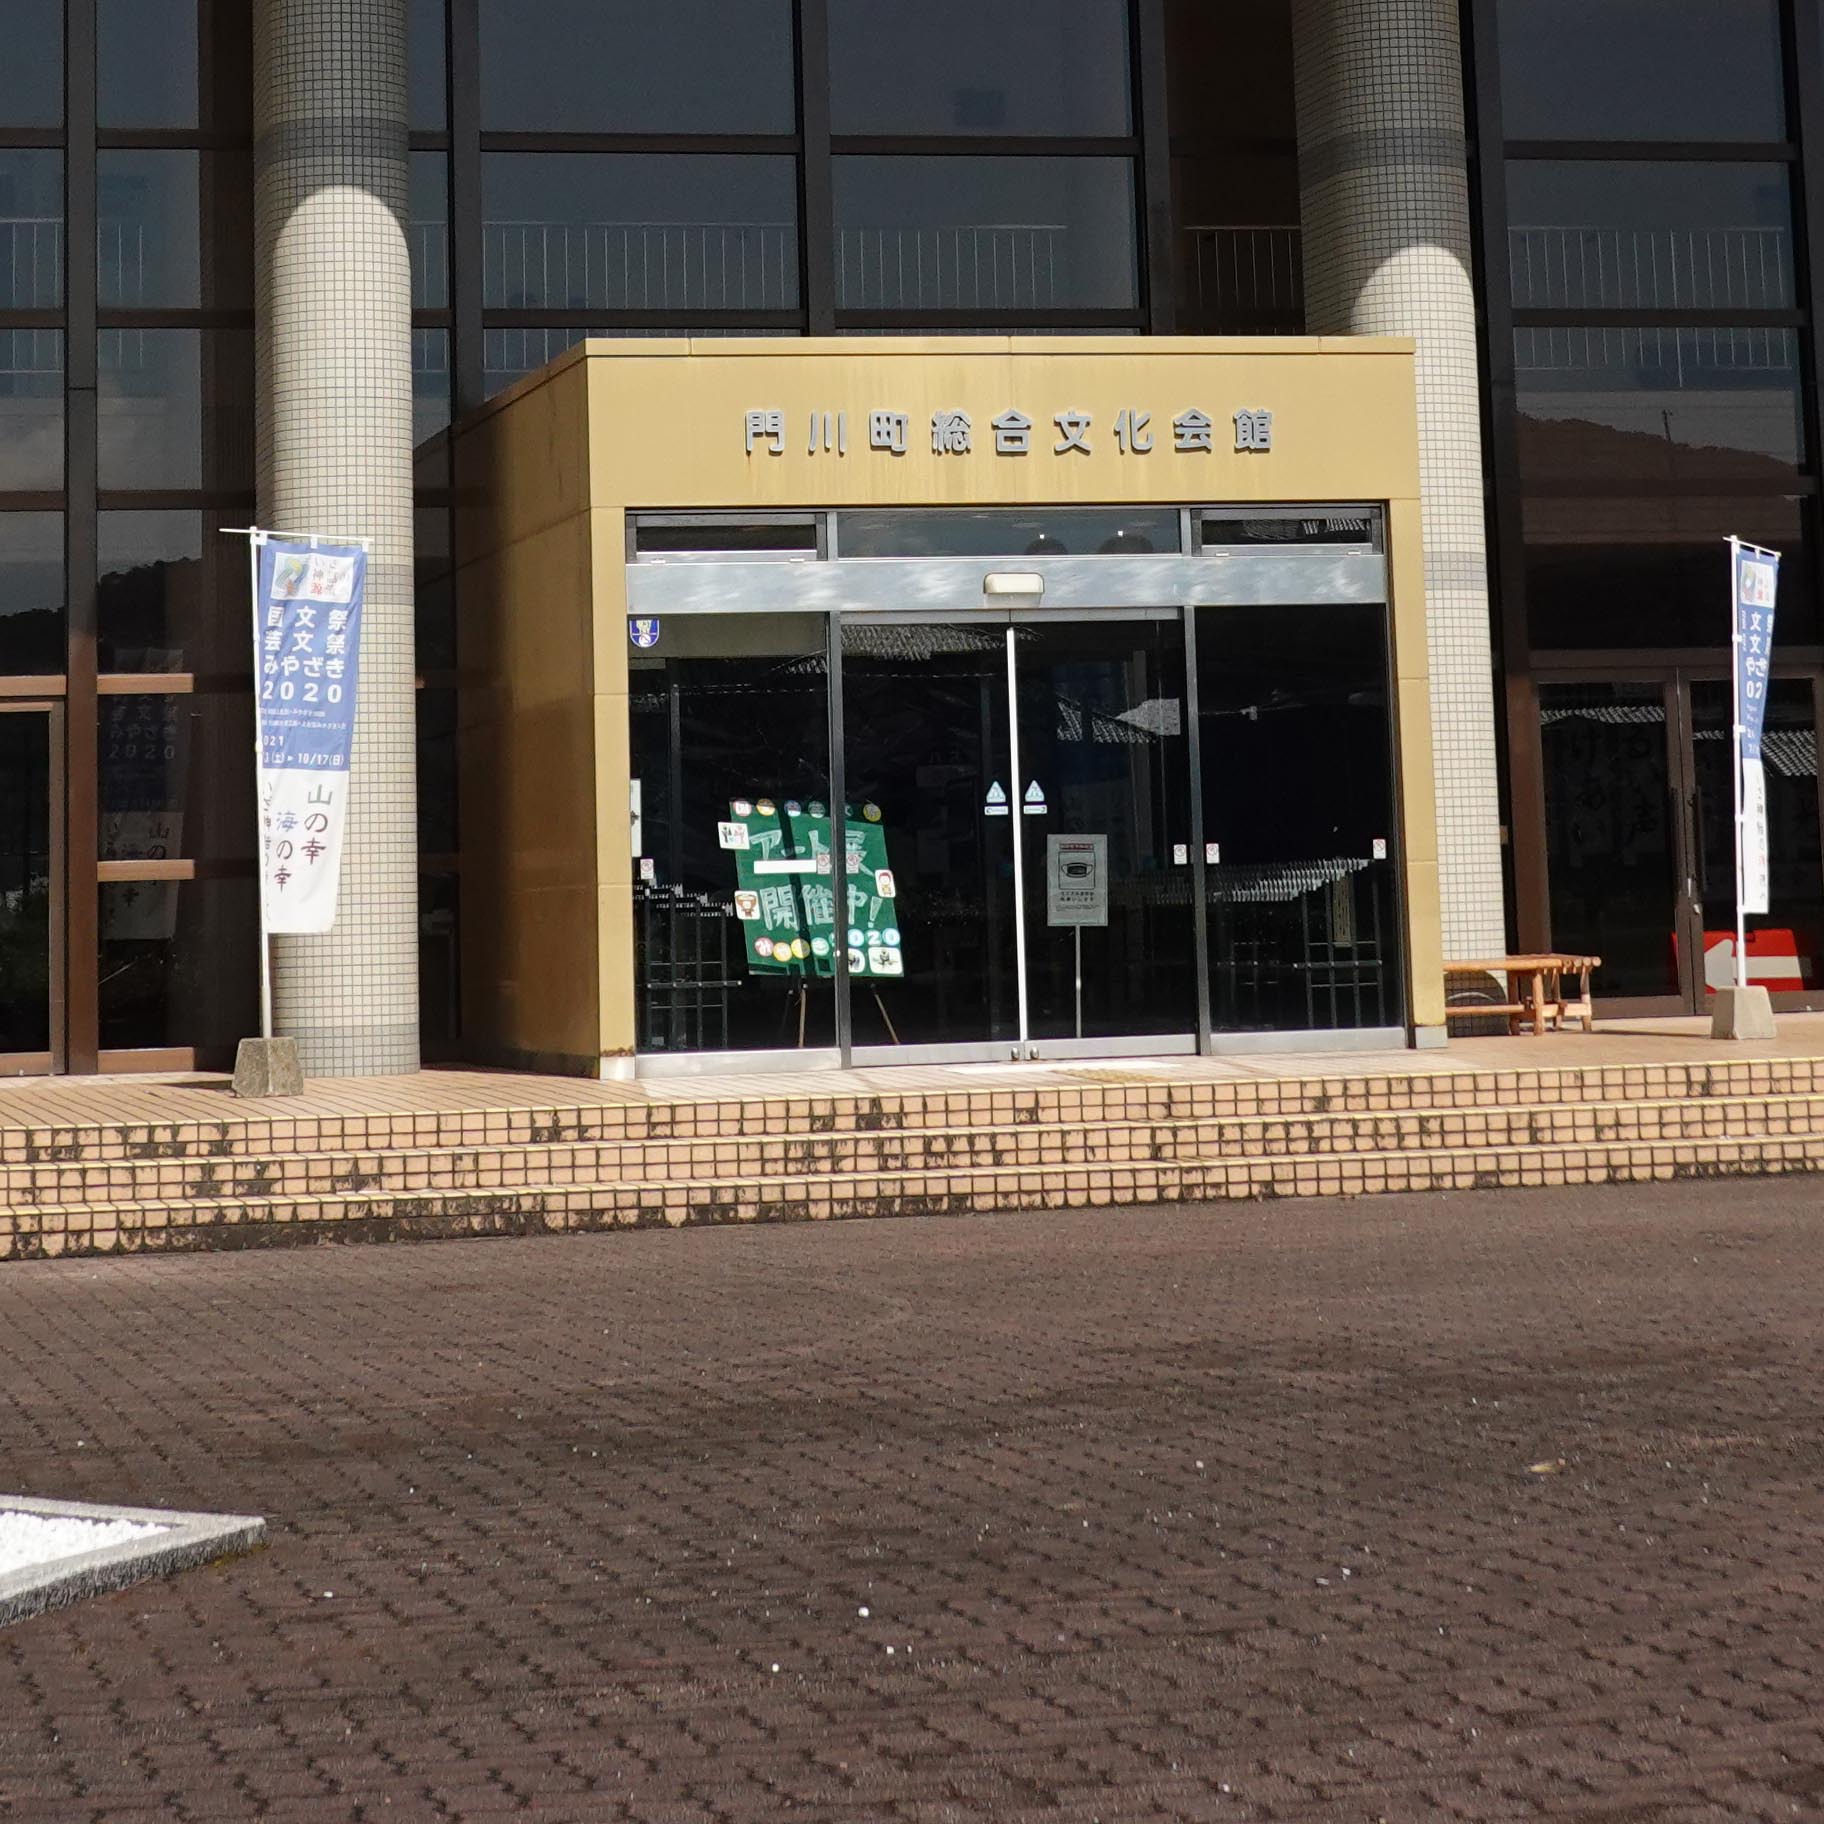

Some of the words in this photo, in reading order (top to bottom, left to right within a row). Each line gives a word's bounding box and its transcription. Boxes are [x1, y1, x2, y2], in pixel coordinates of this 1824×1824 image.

[744, 407, 1274, 455] 門川町総合文化会館
[264, 655, 345, 679] みやざき
[262, 680, 343, 704] 2020
[262, 735, 285, 747] 021
[300, 783, 333, 866] 山の幸
[274, 810, 299, 895] 海の幸
